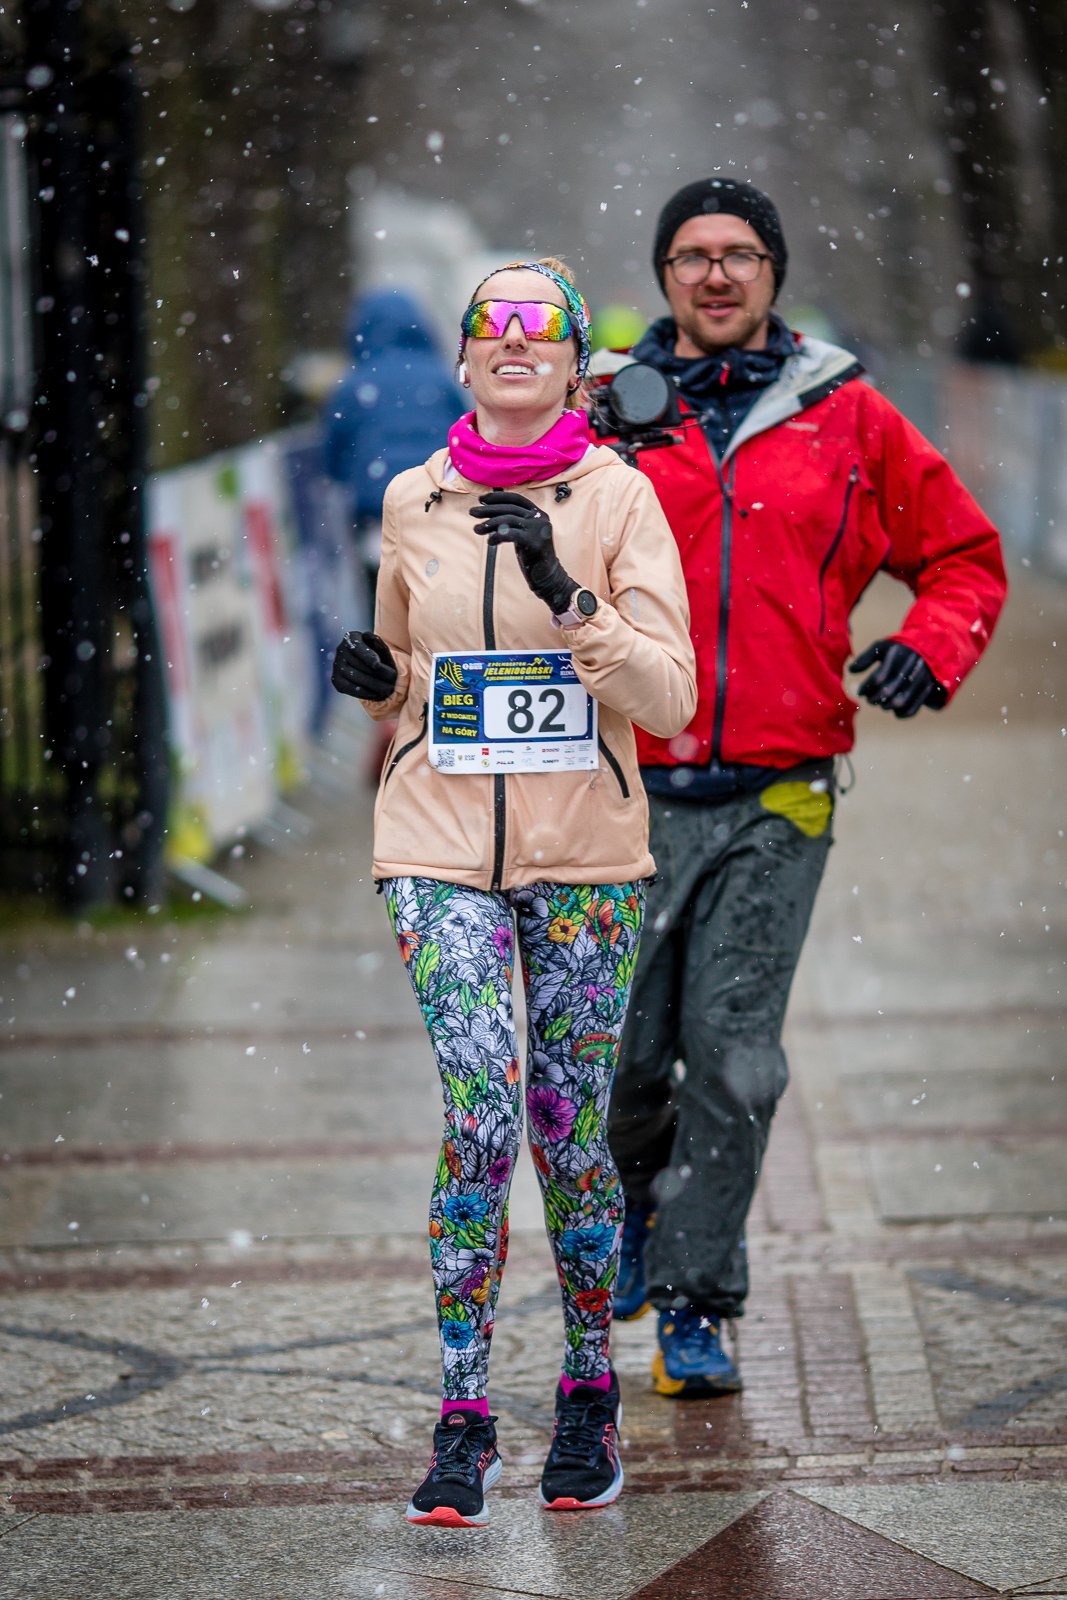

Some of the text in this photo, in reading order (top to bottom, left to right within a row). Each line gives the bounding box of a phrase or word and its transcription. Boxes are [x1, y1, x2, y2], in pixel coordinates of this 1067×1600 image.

[443, 694, 474, 706] BIEG
[507, 688, 566, 734] 82
[441, 726, 478, 737] NA GÓRY
